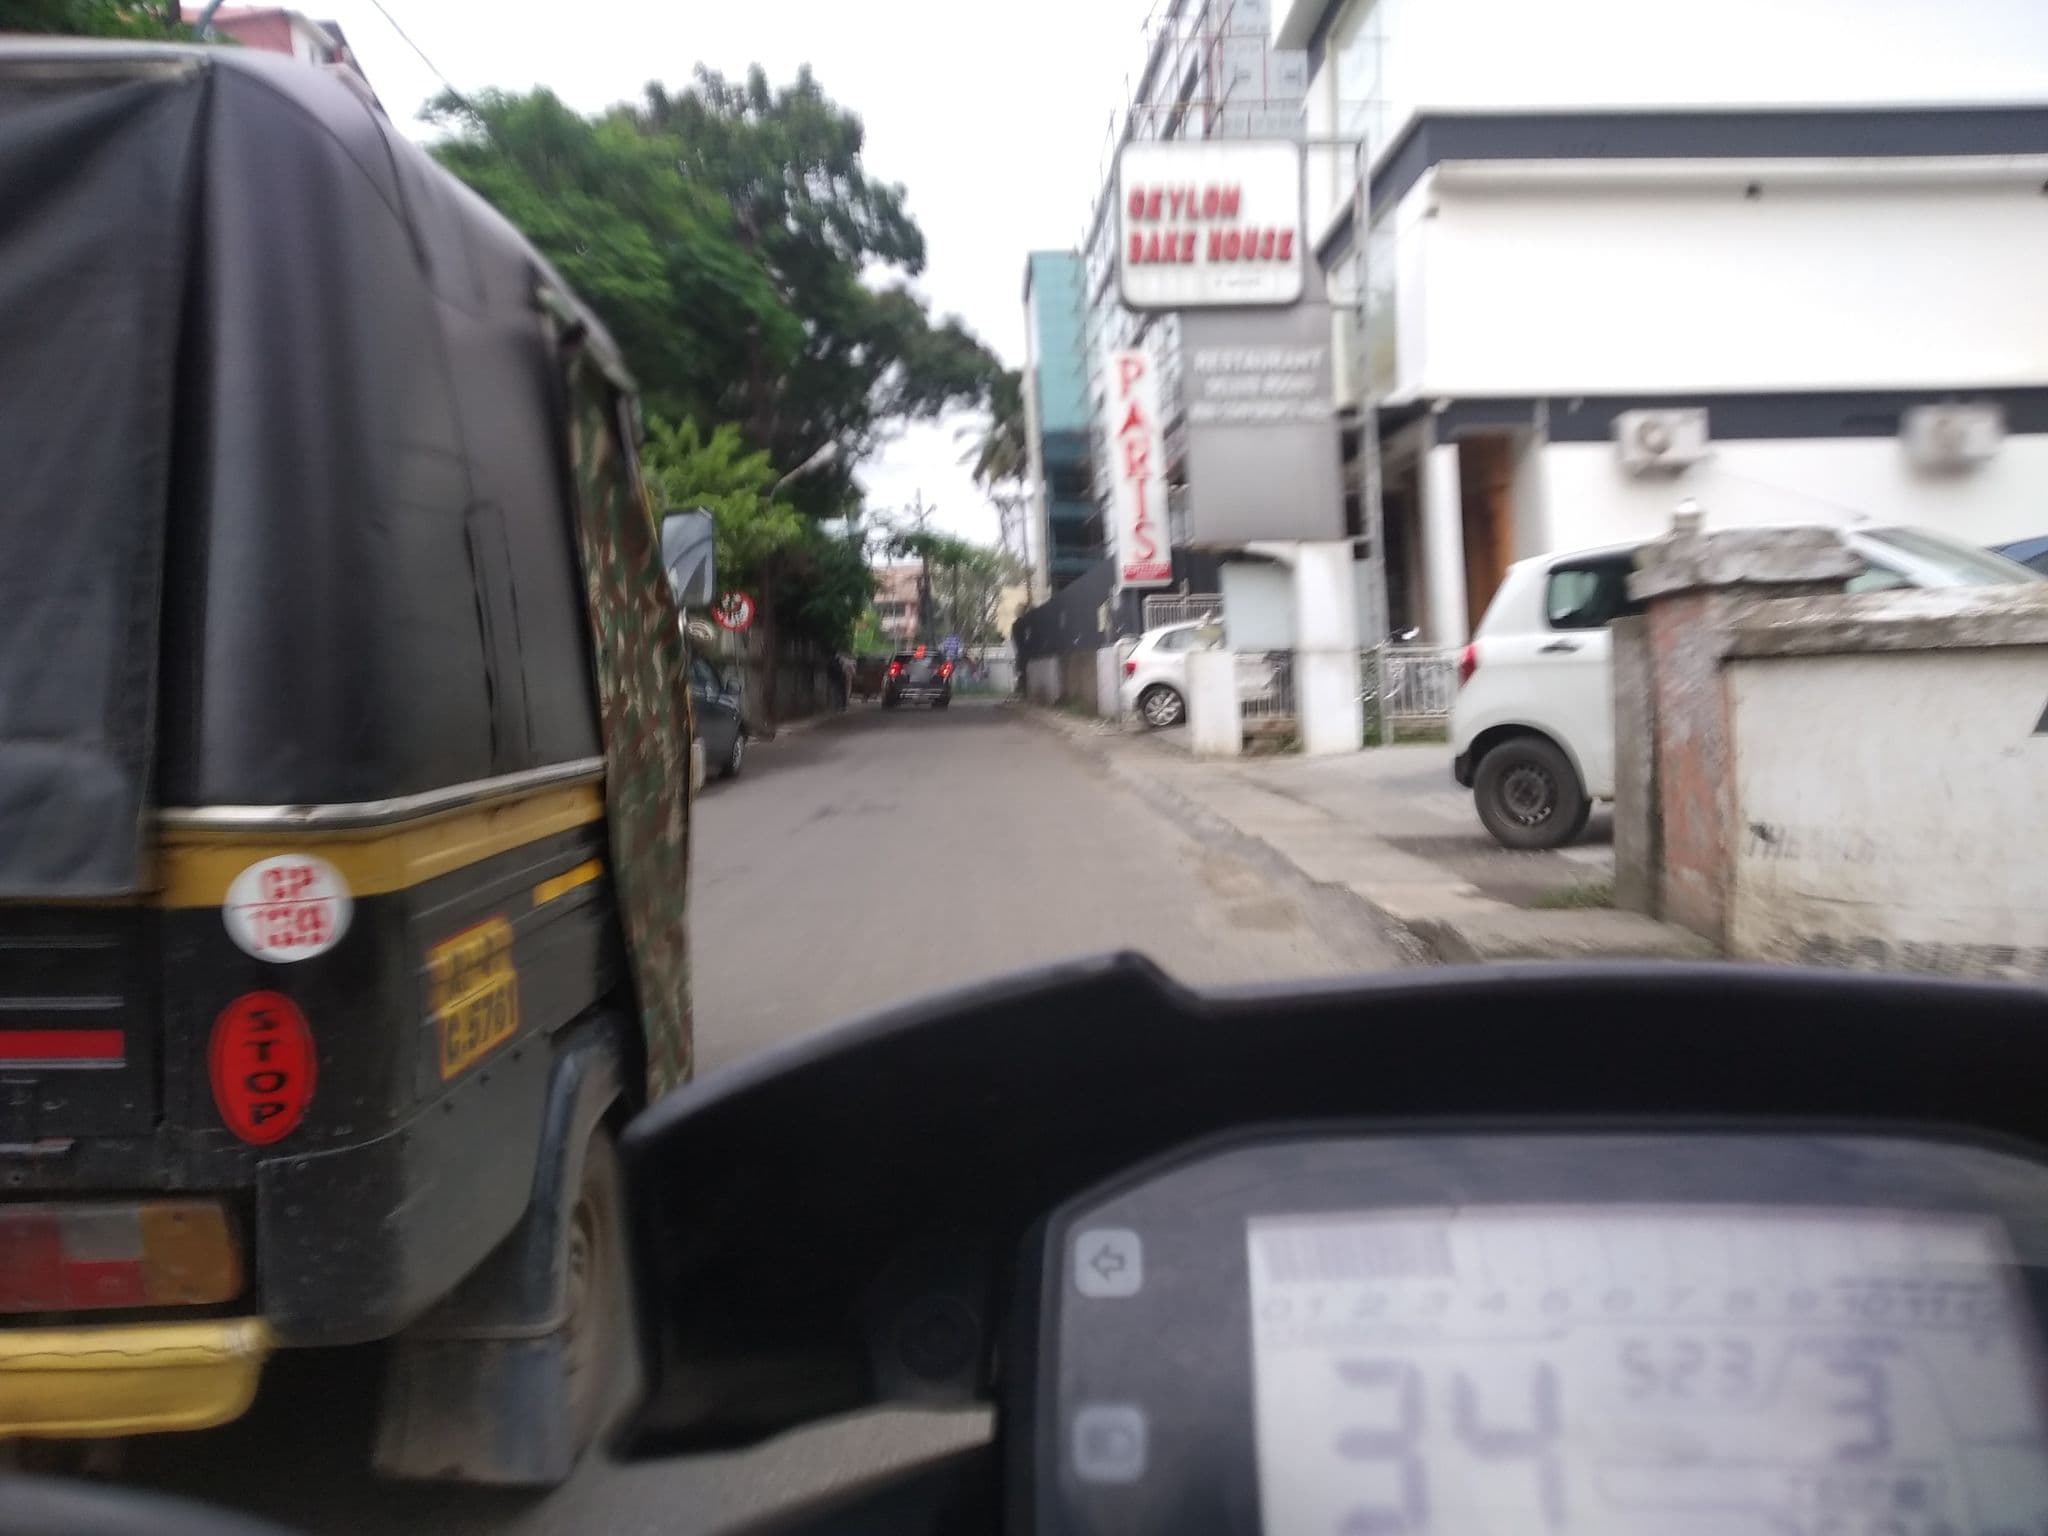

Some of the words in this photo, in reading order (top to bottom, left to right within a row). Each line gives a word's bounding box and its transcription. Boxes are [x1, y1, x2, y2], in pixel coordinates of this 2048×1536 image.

[1127, 230, 1196, 264] BAKE
[1206, 227, 1294, 263] HOUSE
[1113, 354, 1155, 561] PARIS
[242, 1008, 287, 1125] STOP
